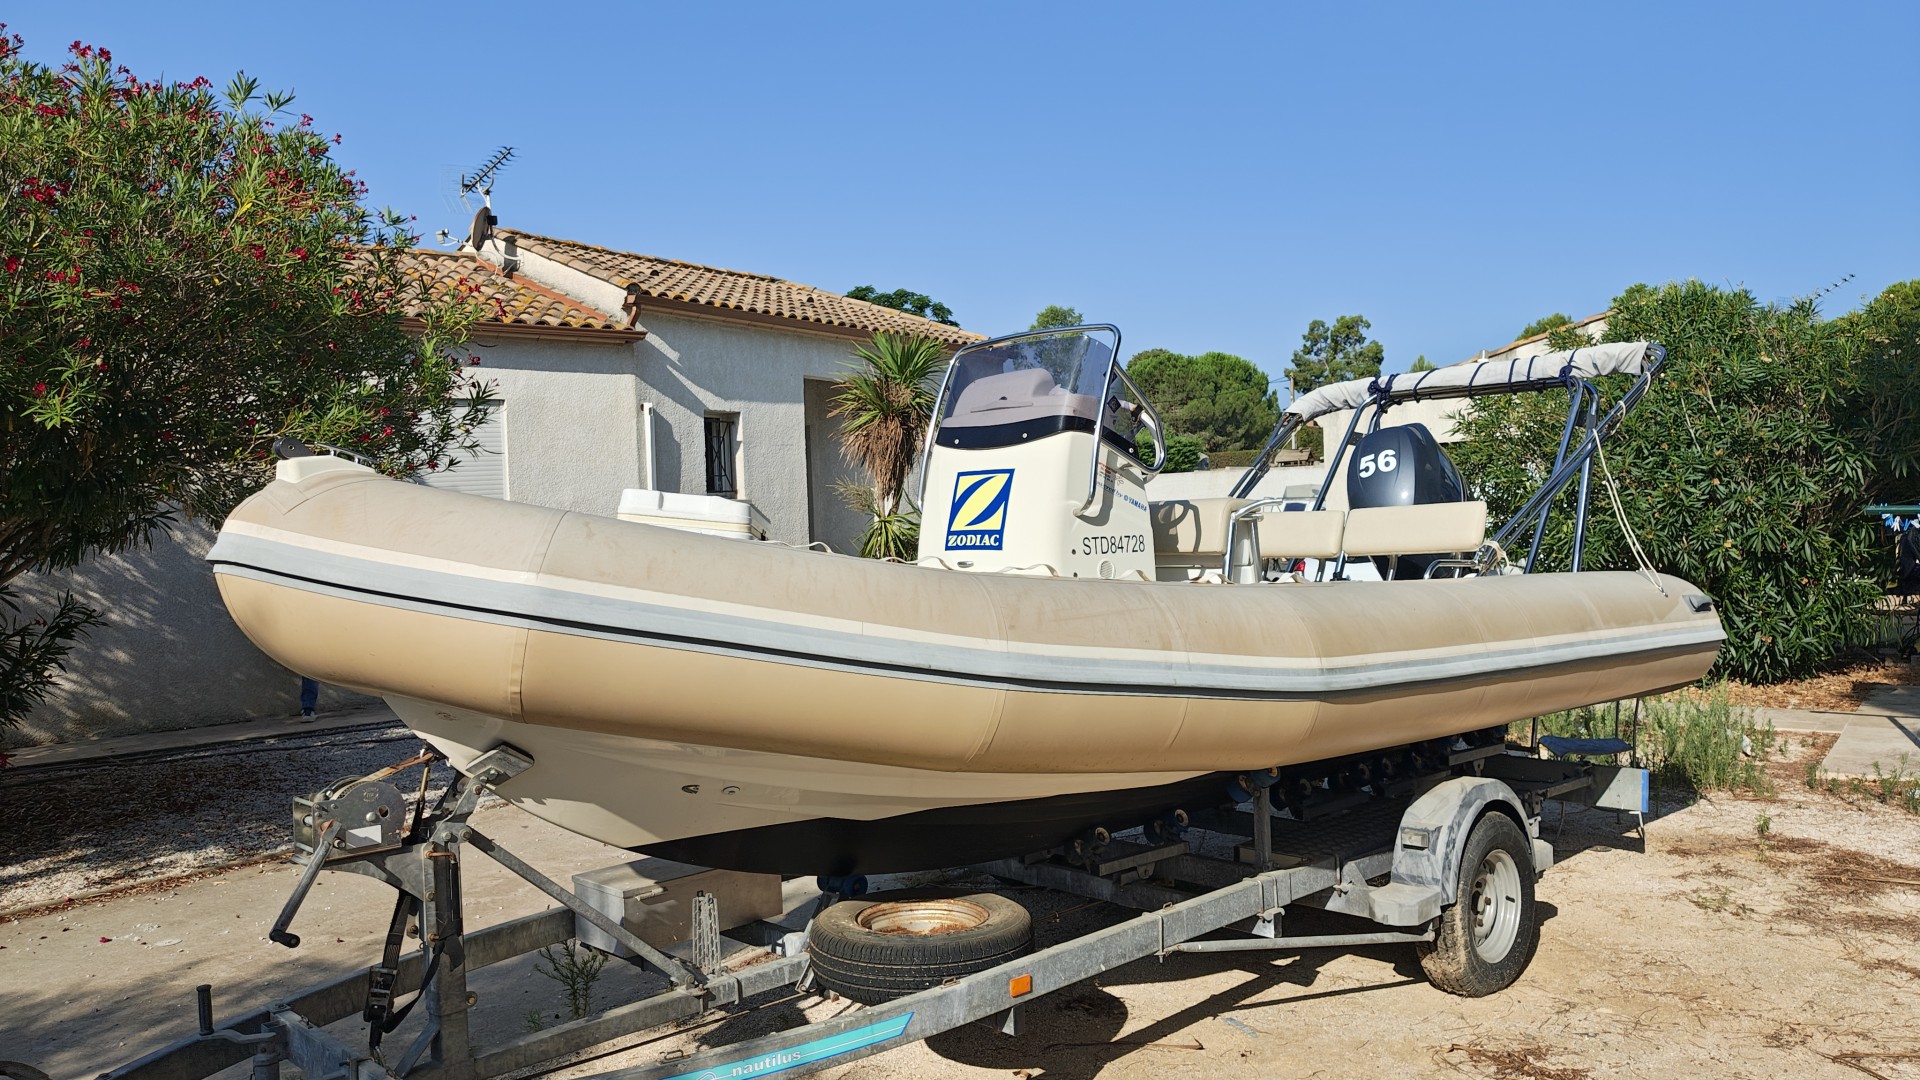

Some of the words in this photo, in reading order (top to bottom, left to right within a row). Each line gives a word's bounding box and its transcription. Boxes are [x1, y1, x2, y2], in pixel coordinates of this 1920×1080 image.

[1359, 449, 1397, 478] 56
[948, 534, 999, 546] ZODIAC
[1082, 534, 1145, 555] STD84728
[732, 1051, 801, 1077] nautilus
